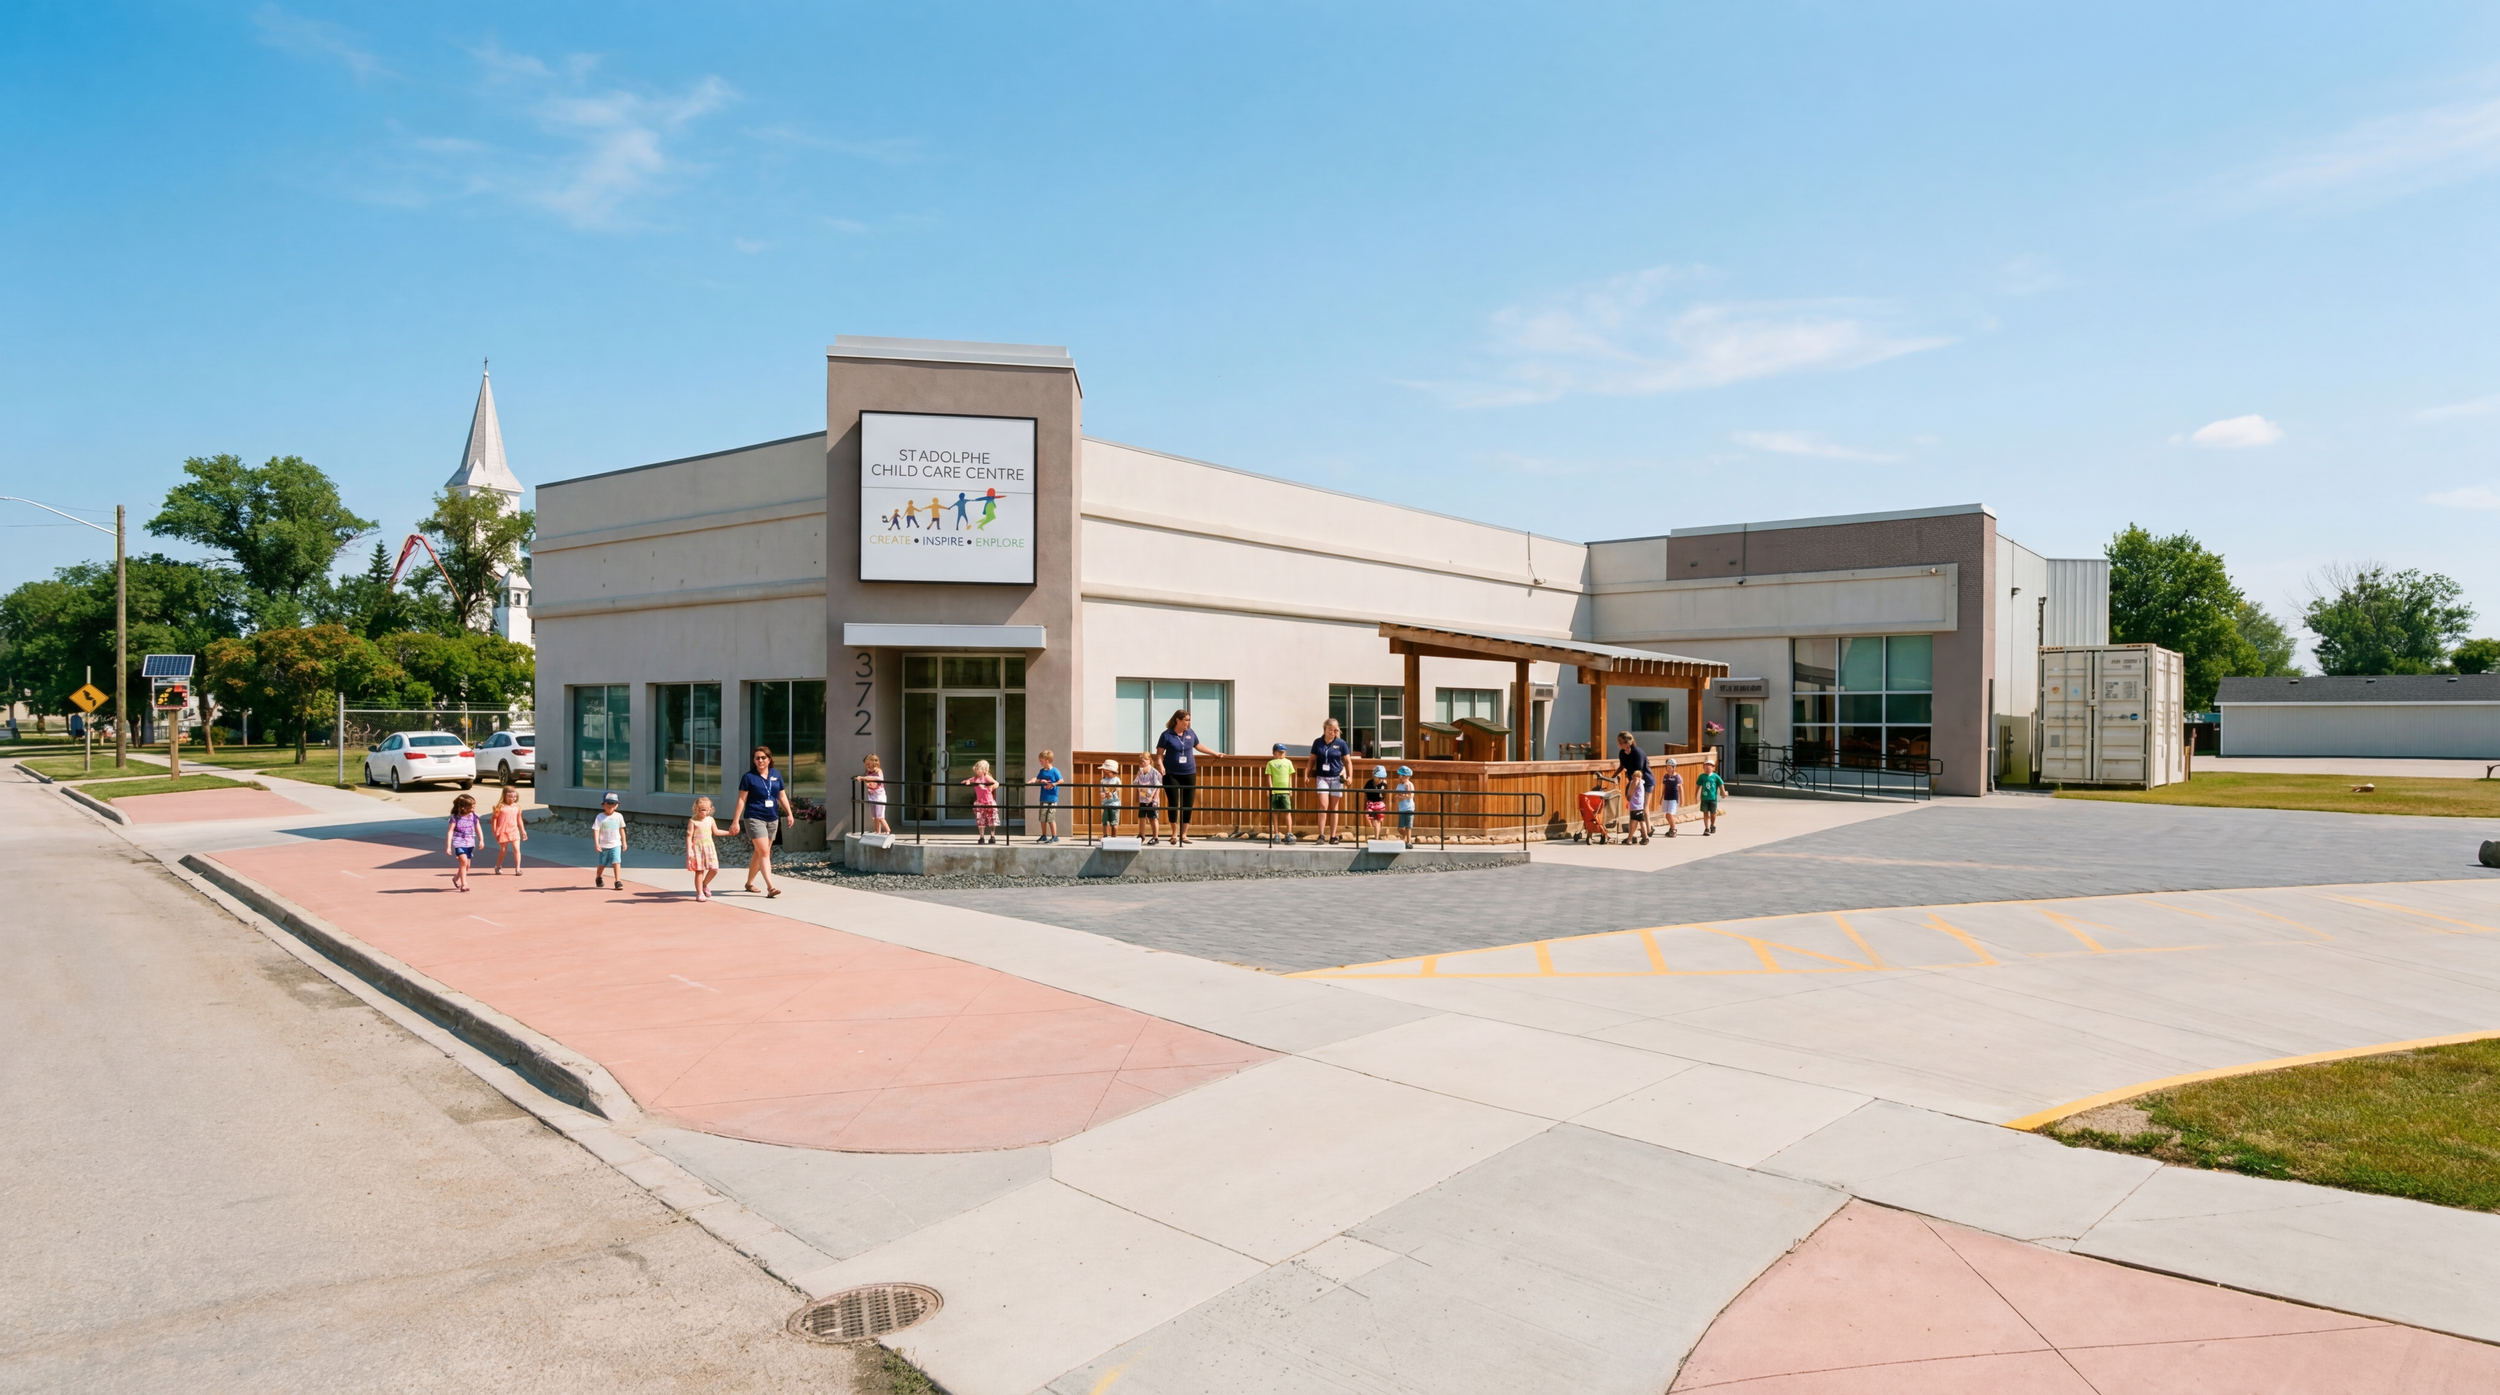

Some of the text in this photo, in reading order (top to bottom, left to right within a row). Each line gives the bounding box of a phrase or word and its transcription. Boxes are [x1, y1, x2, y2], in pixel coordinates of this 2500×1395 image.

[899, 449, 991, 465] ST ADOLPHE
[871, 463, 1025, 481] CHILD CARE CENTRE
[869, 535, 911, 545] CREATE
[922, 536, 964, 547] INSPIRE
[854, 652, 873, 736] 372
